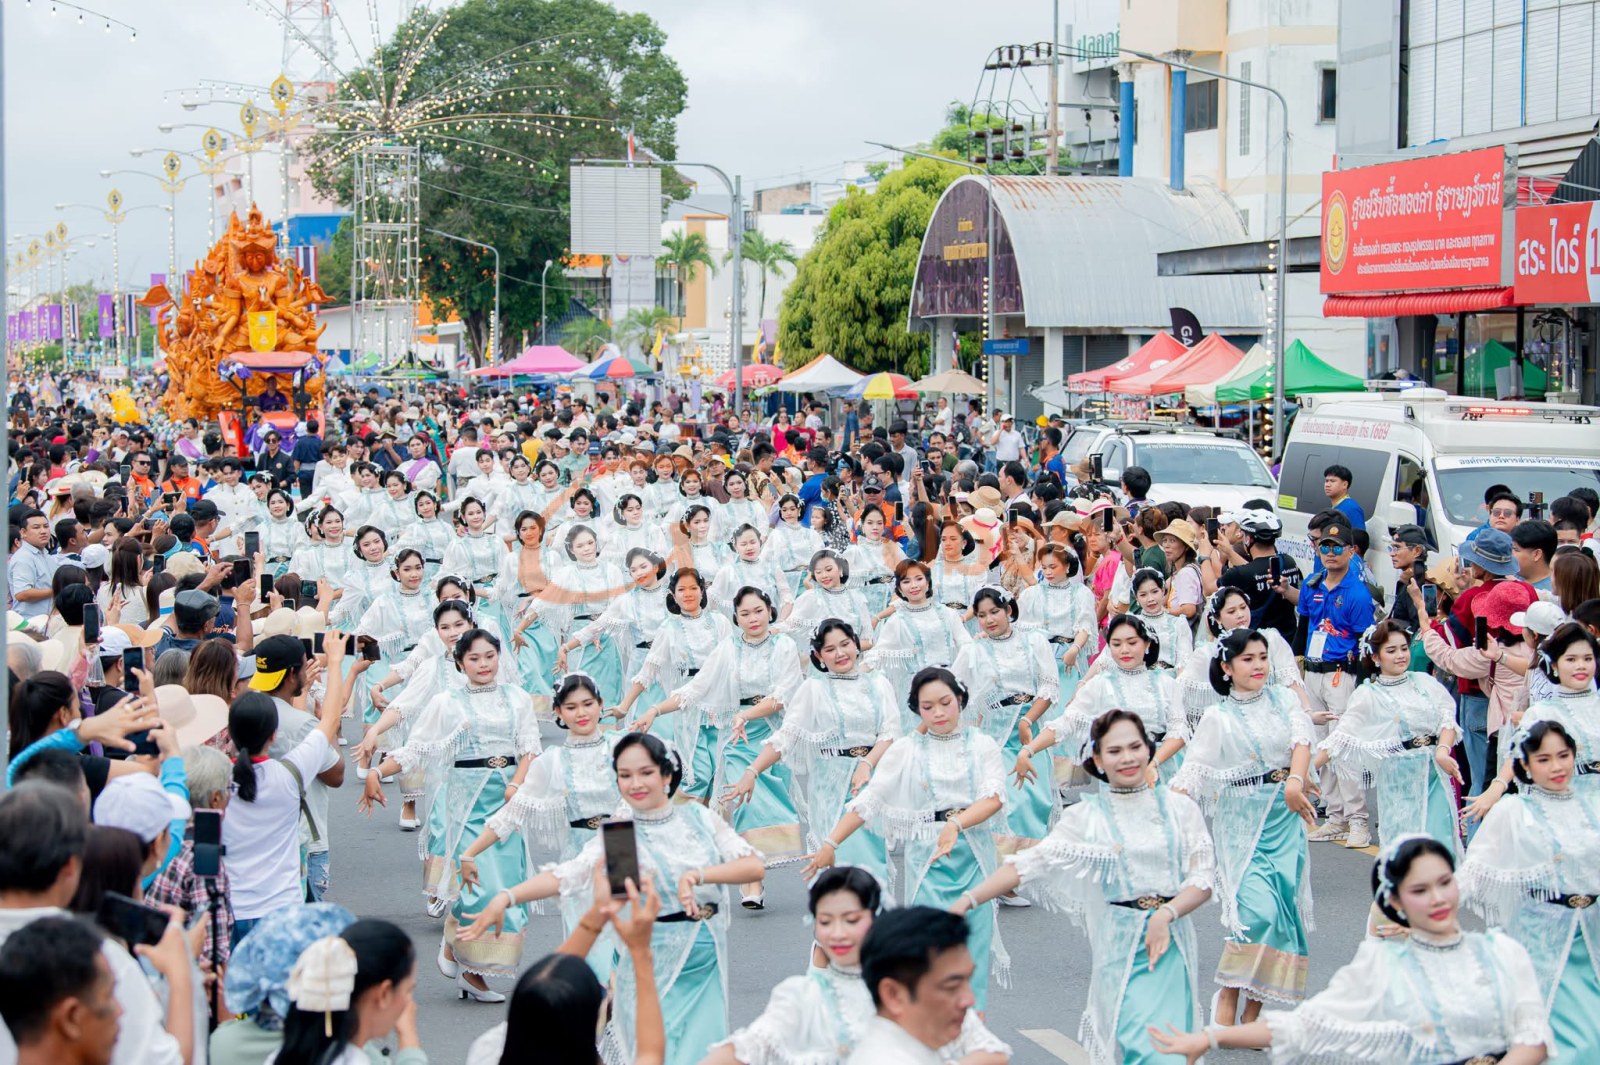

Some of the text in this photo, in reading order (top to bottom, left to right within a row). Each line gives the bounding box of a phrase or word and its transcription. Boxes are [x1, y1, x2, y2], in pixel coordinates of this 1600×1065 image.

[1518, 238, 1546, 276] สระ
[1549, 217, 1580, 275] ไดร์
[1370, 423, 1391, 440] 1669
